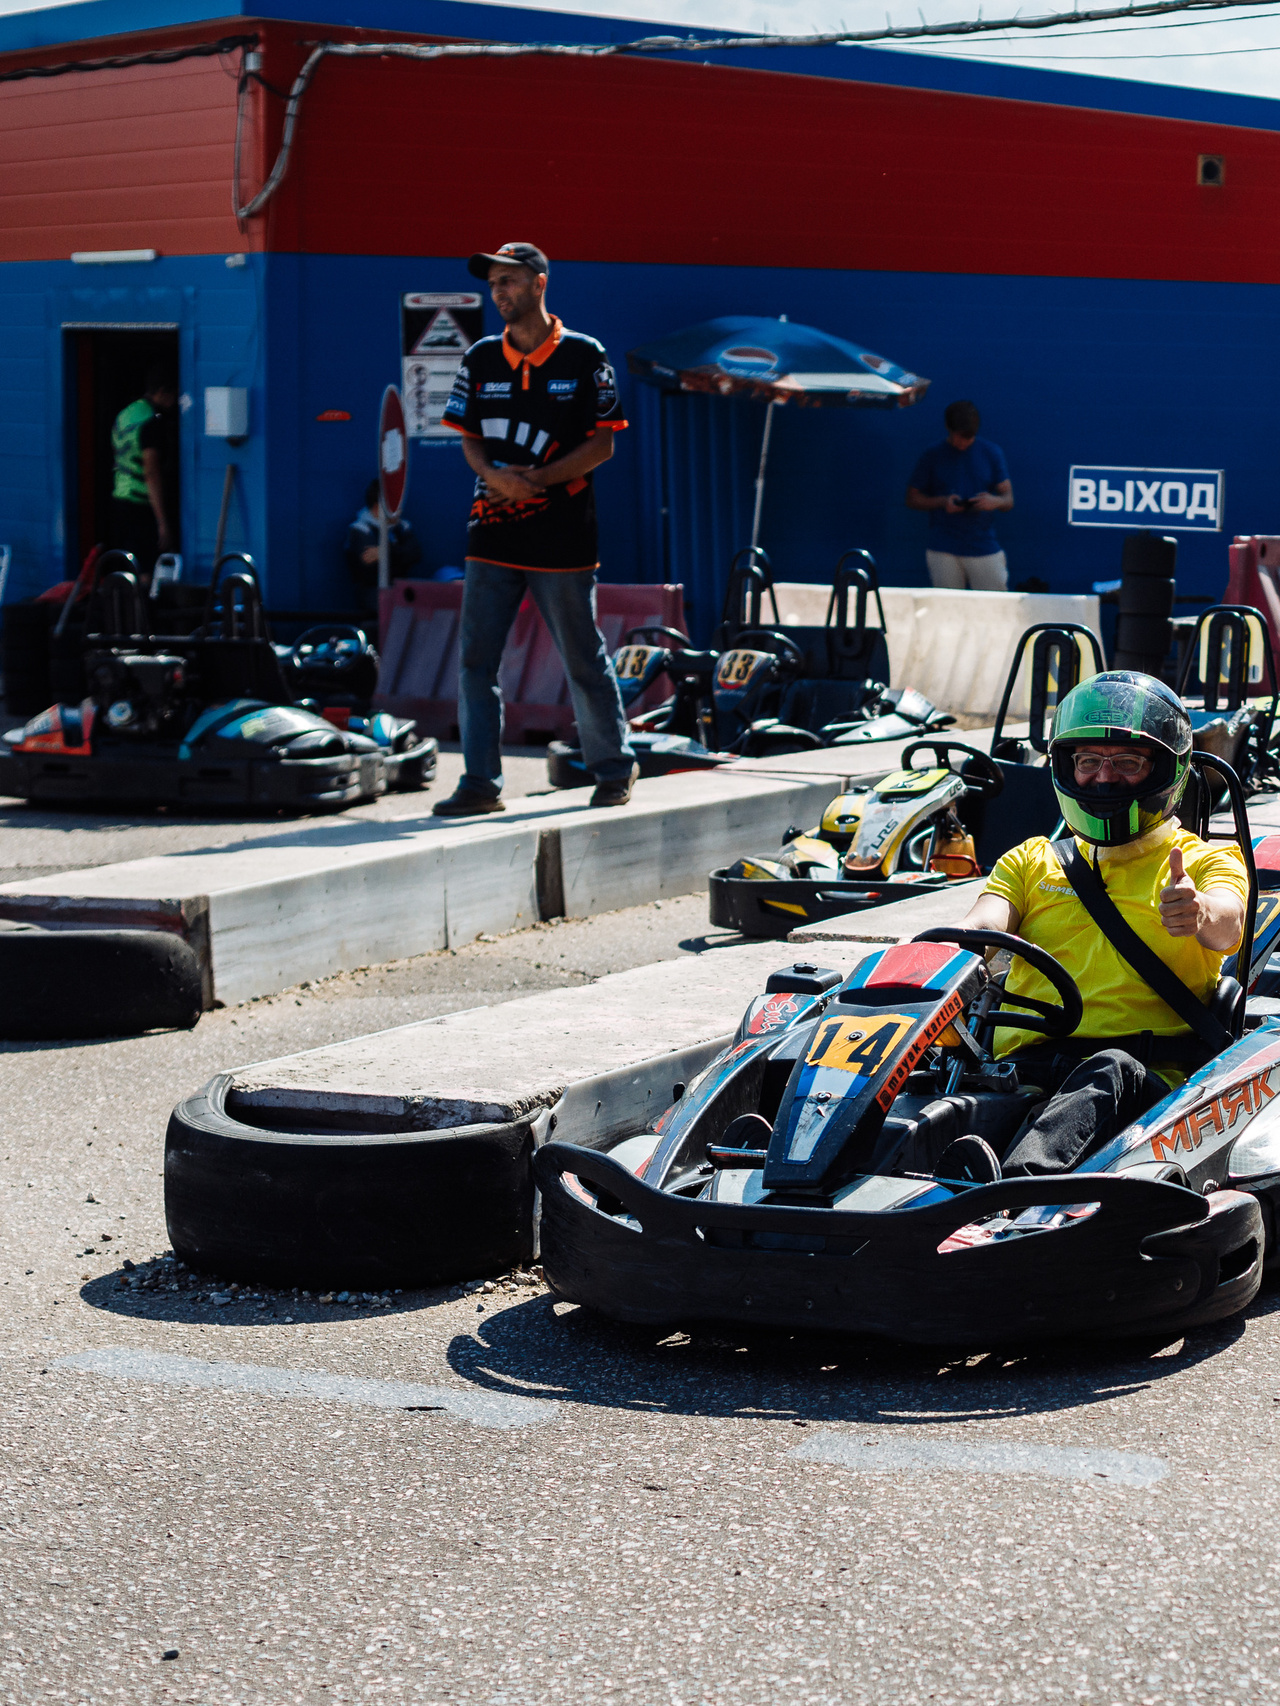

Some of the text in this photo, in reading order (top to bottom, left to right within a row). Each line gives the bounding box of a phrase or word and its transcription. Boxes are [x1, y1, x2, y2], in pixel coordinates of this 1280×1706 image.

[1071, 477, 1217, 520] ВЫХОД
[616, 647, 648, 677] 33
[721, 651, 755, 681] 33
[809, 1022, 902, 1077] 14
[1150, 1066, 1277, 1161] МАЯК
